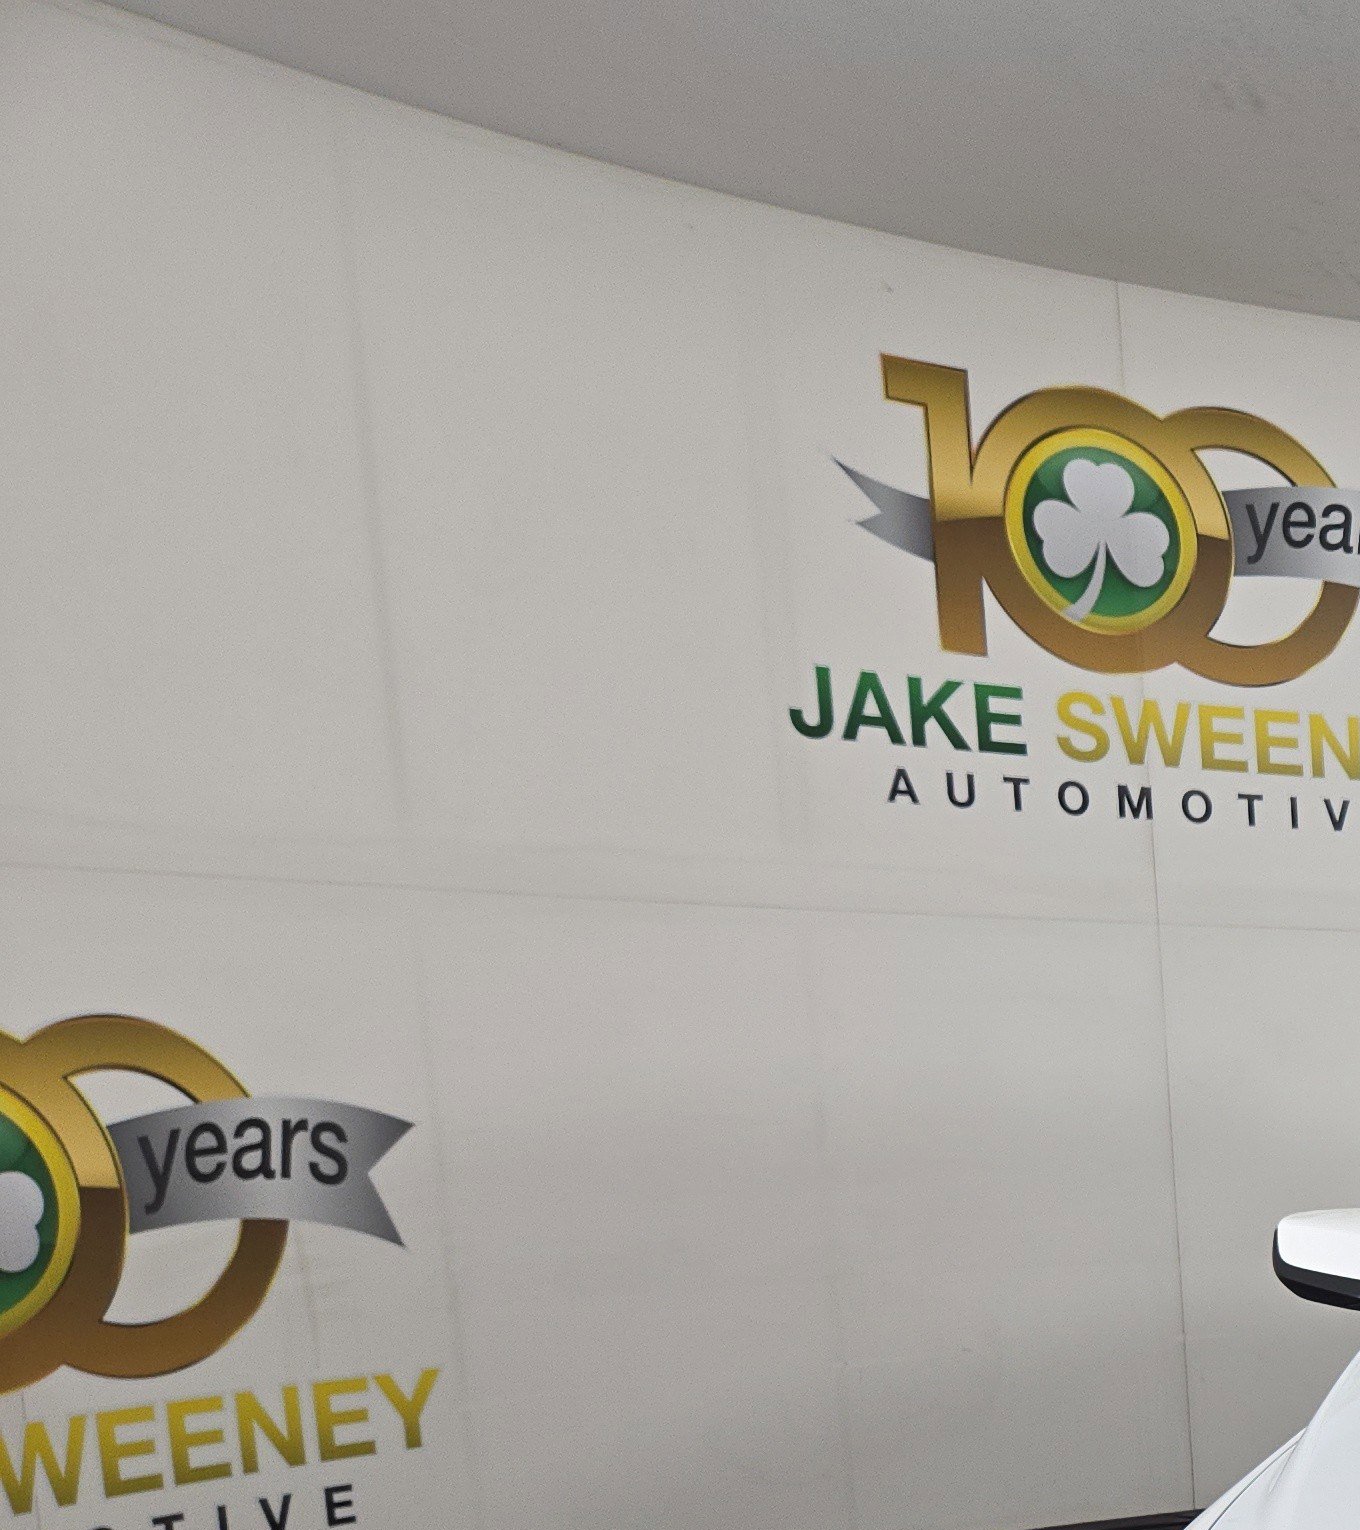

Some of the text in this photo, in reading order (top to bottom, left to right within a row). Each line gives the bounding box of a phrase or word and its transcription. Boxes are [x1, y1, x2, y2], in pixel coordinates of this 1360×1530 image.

[880, 353, 1360, 687] 100
[789, 665, 1028, 757] JAKE
[138, 1116, 349, 1215] years
